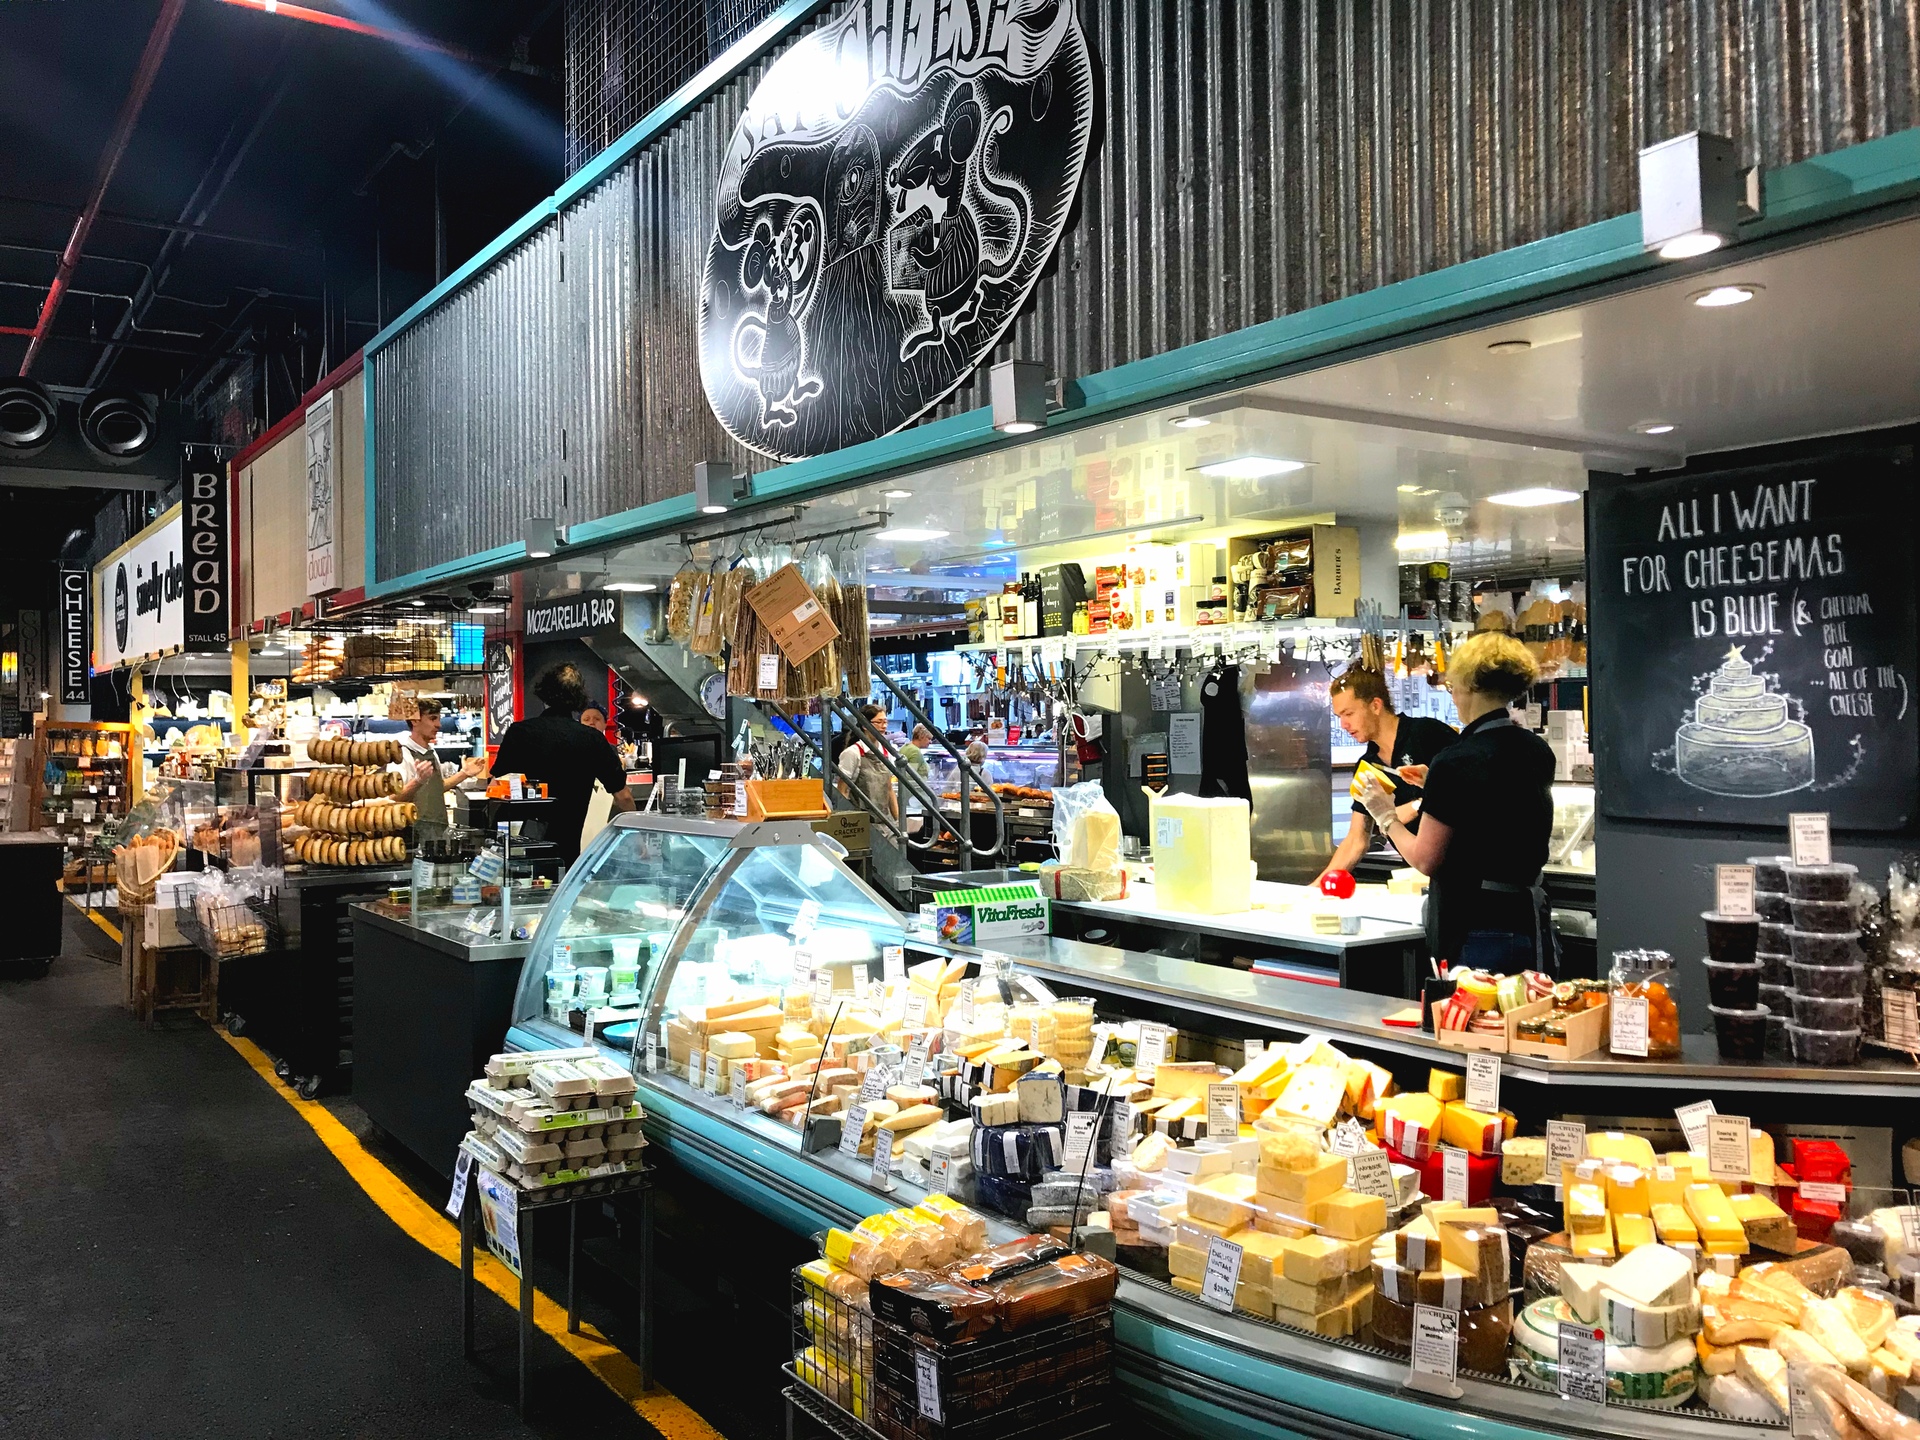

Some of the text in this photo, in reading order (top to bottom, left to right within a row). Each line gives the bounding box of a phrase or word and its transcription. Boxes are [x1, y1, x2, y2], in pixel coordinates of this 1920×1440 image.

[1657, 478, 1818, 542] ALL I WANT
[164, 550, 184, 603] che
[308, 547, 333, 587] dough
[1623, 533, 1846, 595] FOR CHEESEMAS
[64, 574, 83, 687] CHEESE
[526, 598, 616, 635] MOZZARELLA BAR
[1691, 598, 1717, 638] IS
[1723, 592, 1784, 637] BLUE
[188, 632, 227, 643] STALL 45
[1824, 646, 1853, 669] GOAT
[1828, 670, 1849, 690] ALL
[1853, 667, 1868, 690] OF
[1877, 664, 1898, 689] THE
[65, 690, 85, 701] 44
[1829, 692, 1876, 717] CHEESE
[833, 827, 865, 836] CRACKERS
[977, 902, 1045, 924] VitaFresh
